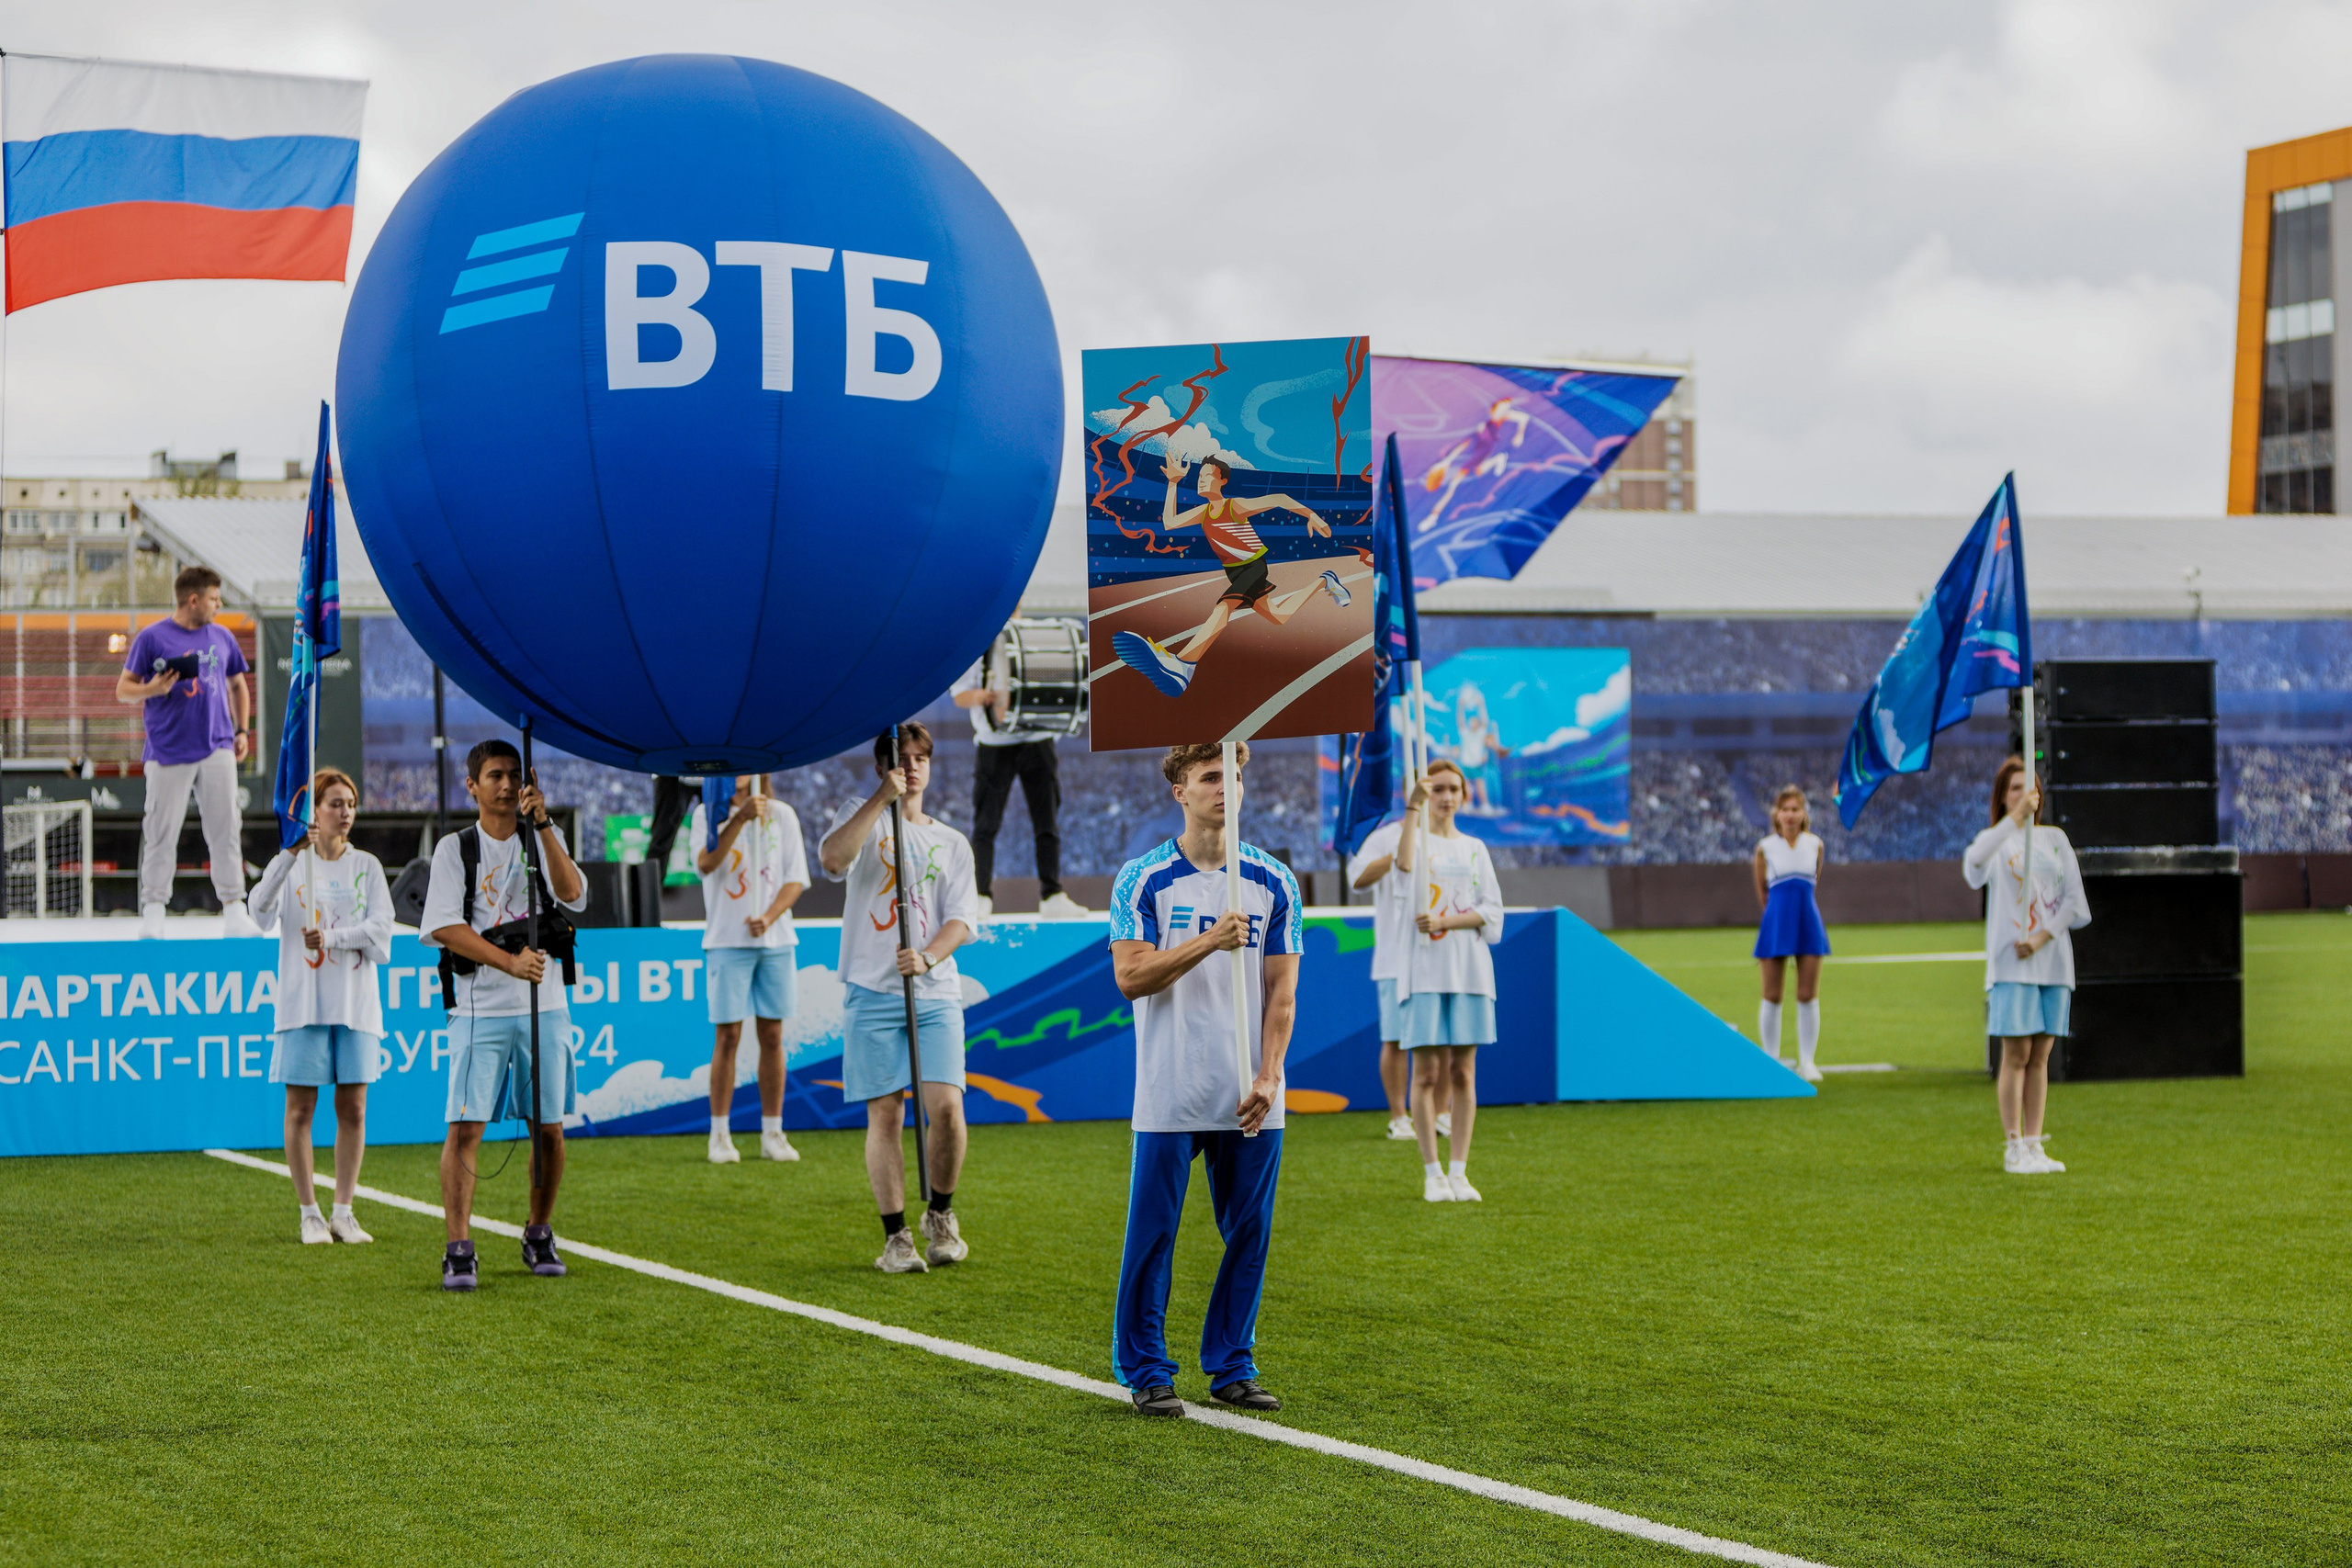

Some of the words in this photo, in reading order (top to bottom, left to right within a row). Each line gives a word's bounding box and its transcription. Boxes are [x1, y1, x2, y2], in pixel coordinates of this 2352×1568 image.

[604, 240, 944, 402] ВТБ
[0, 970, 278, 1020] АРТАКИА
[639, 959, 704, 1003] ВТ
